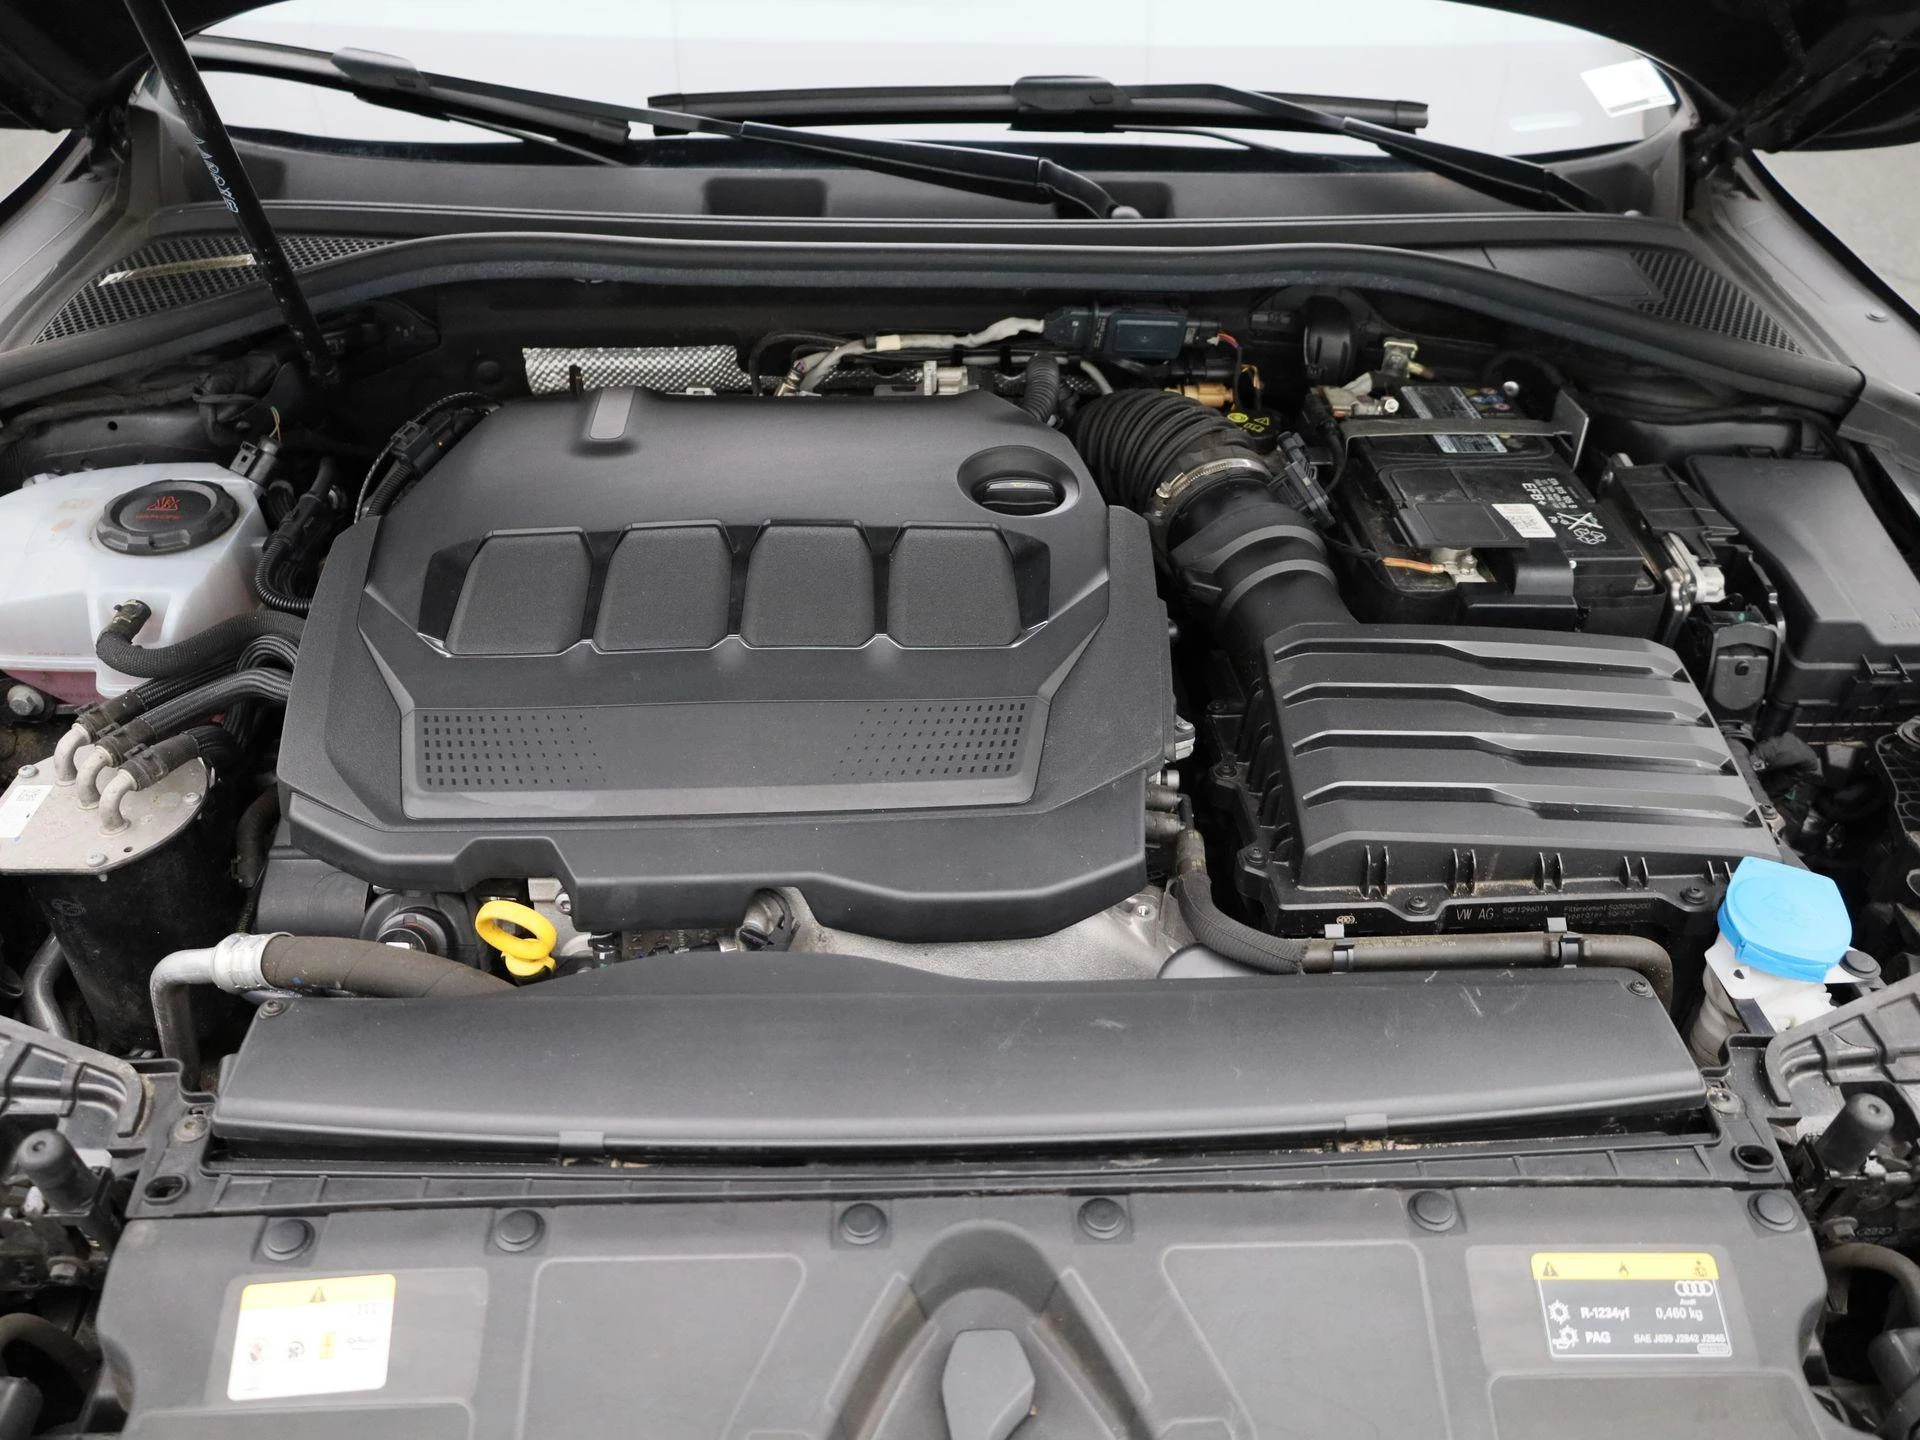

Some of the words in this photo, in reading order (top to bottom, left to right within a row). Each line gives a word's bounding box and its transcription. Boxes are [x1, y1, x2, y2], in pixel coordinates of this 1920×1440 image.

[1521, 482, 1547, 506] EFB+
[1456, 908, 1471, 921] VW
[1478, 907, 1494, 921] AG
[1580, 1306, 1630, 1321] R-1234yf
[1689, 1306, 1704, 1321] kg
[1585, 1331, 1612, 1344] PAG
